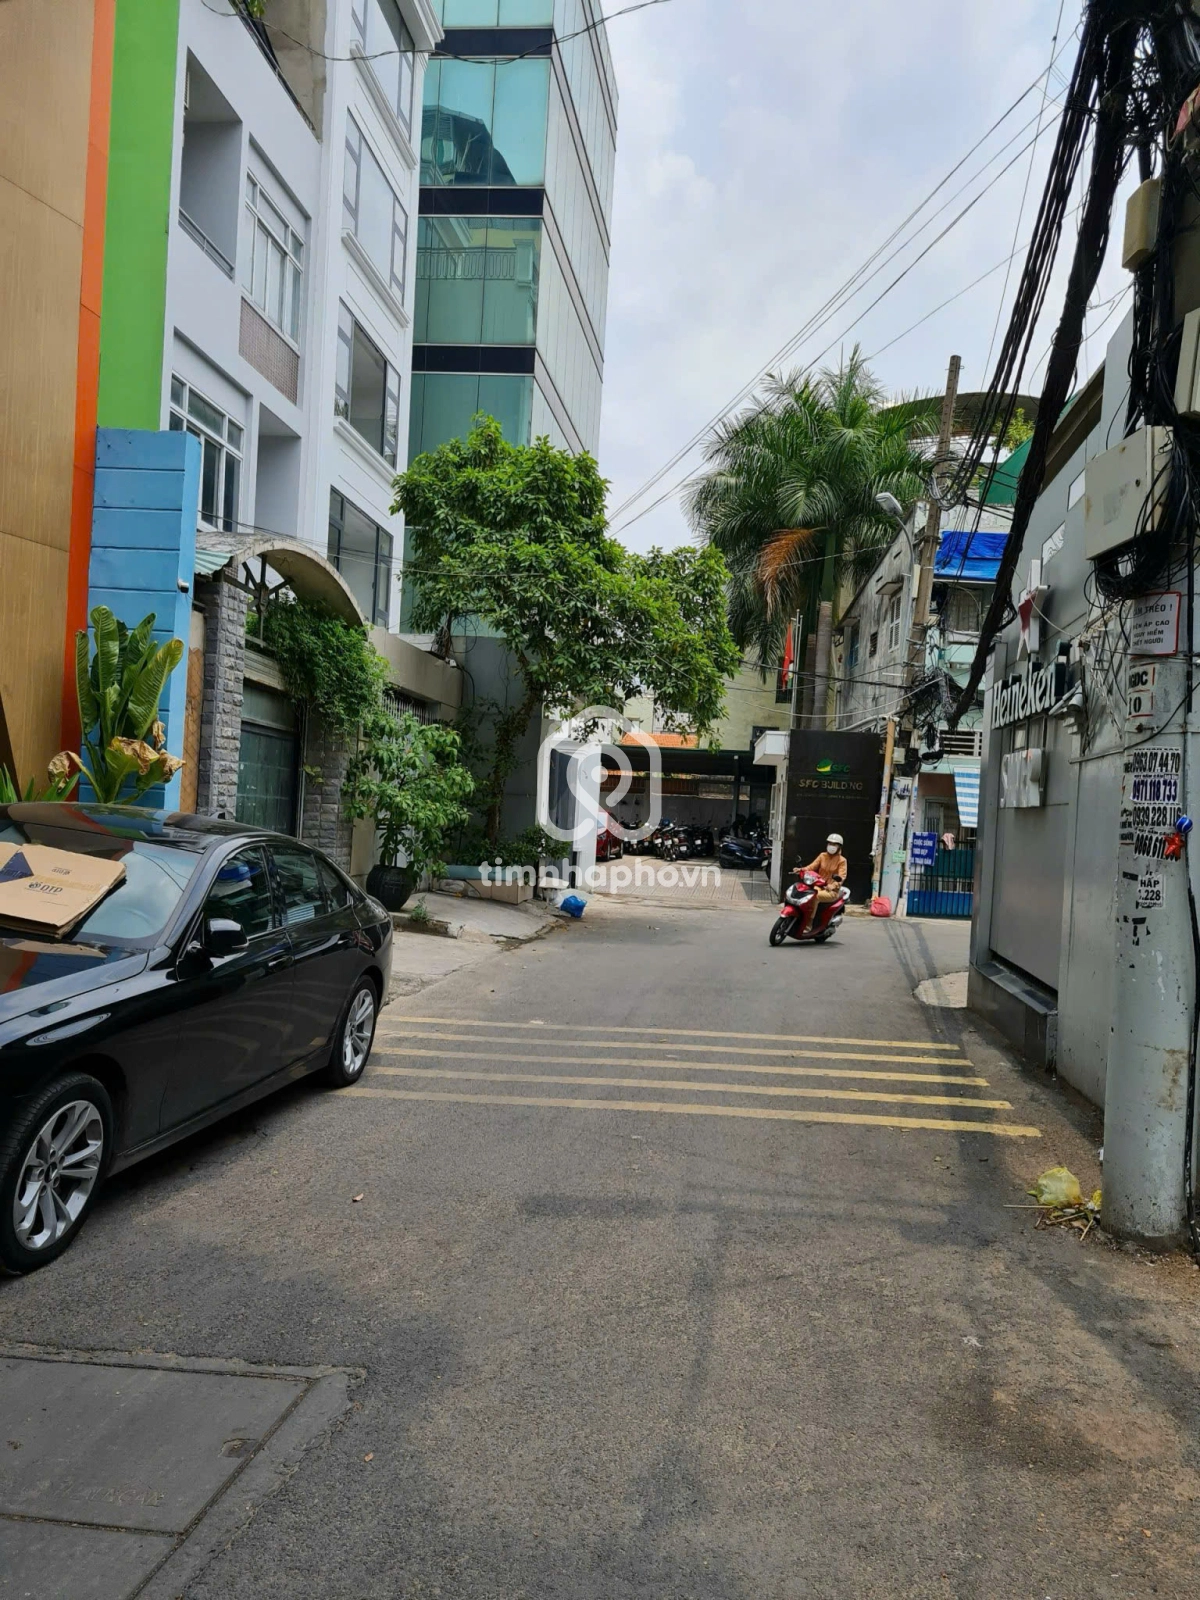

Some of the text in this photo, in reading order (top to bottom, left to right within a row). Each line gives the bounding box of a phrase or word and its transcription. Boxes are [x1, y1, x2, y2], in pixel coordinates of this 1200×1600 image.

[992, 660, 1057, 730] Heineken
[798, 778, 863, 790] SFC BUILDNG
[1140, 876, 1160, 888] HẤP
